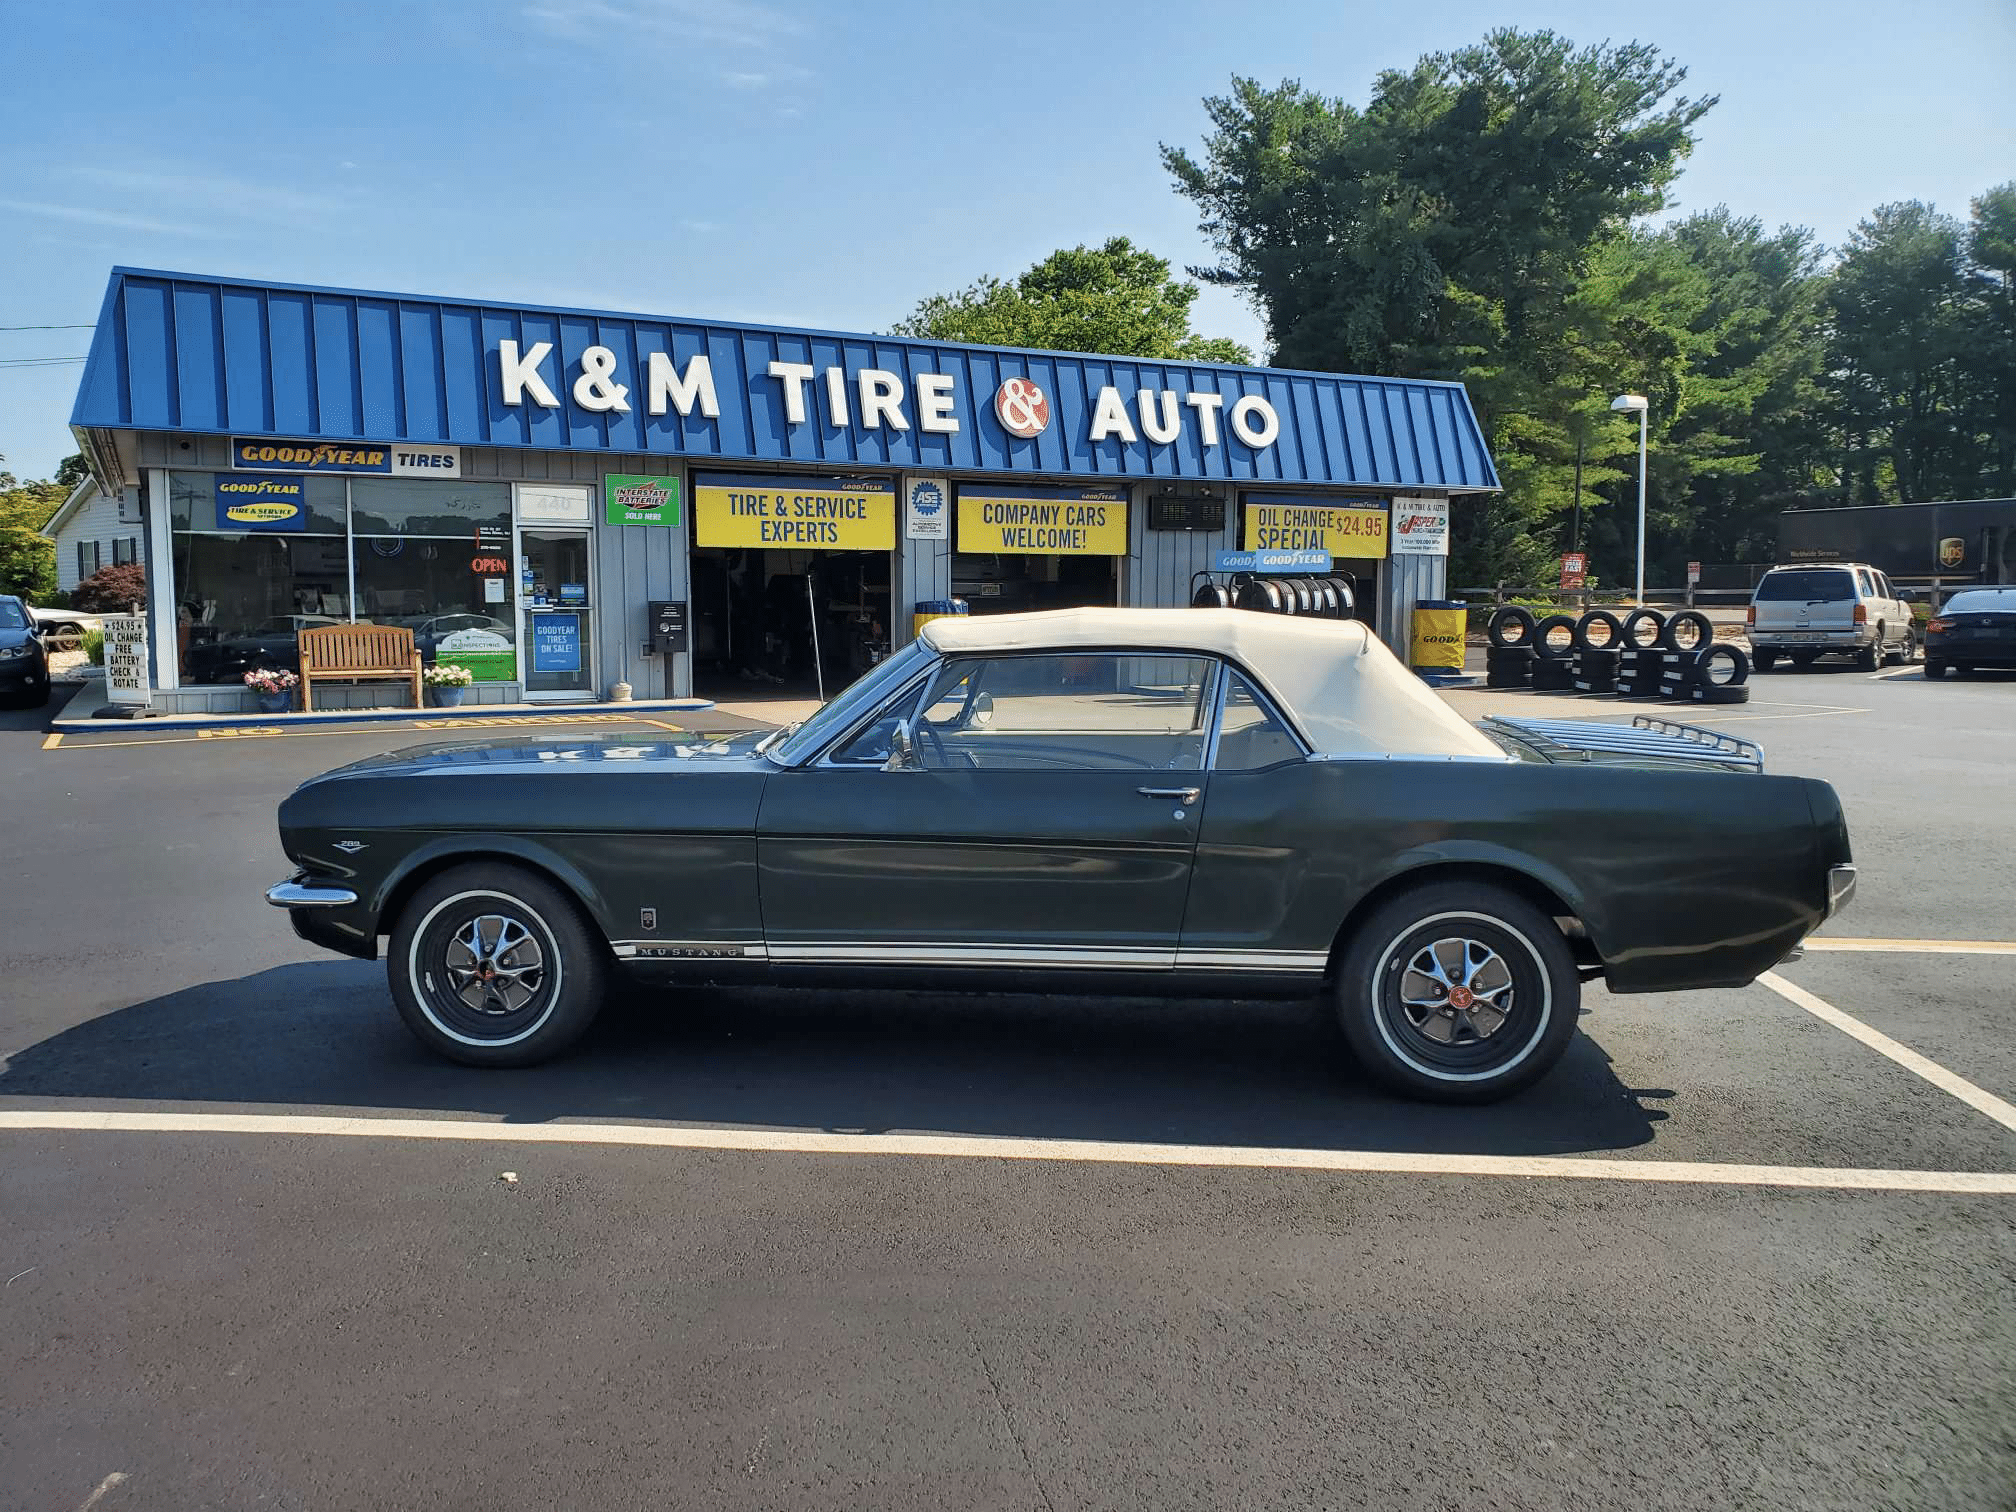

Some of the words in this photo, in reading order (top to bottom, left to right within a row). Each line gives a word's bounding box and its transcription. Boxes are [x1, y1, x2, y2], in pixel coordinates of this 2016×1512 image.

[500, 339, 561, 409] K
[573, 345, 632, 413] &
[648, 352, 721, 418] M
[768, 361, 960, 433] TIRE
[998, 377, 1048, 436] &
[1089, 386, 1280, 449] AUTO
[241, 444, 384, 467] GOODYEAR
[398, 453, 455, 469] TIRES
[219, 481, 300, 494] GOODYEAR
[841, 482, 882, 491] GOODYEAR
[616, 489, 669, 497] INTERSTATE
[916, 491, 938, 504] ASE
[1081, 492, 1117, 501] GOODYEAR
[618, 496, 666, 504] BATTERIES
[728, 494, 768, 516] TIRE
[775, 496, 788, 517] &
[793, 496, 866, 519] SERVICE
[625, 512, 643, 520] SOLD
[983, 503, 1060, 526] COMPANY
[1066, 506, 1105, 526] CARS
[1258, 508, 1279, 526] OIL
[1283, 509, 1334, 528] CHANGE
[1336, 516, 1382, 536] $24.95
[761, 520, 838, 543] EXPERTS
[1002, 528, 1087, 549] WELCOME!
[1258, 528, 1324, 550] SPECIAL
[1222, 556, 1256, 567] GOOD
[1263, 550, 1325, 566] GOODYEAR
[471, 558, 507, 573] OPEN
[111, 621, 135, 630] $24.95
[537, 626, 576, 635] GOODYEAR
[104, 632, 114, 642] OIL
[117, 632, 142, 642] CHANGE
[546, 635, 567, 644] TIRES
[1423, 634, 1461, 644] GOOD
[115, 644, 132, 653] FREE
[541, 644, 552, 653] ON
[110, 655, 139, 665] BATTERY
[110, 666, 131, 676] CHECK
[113, 679, 139, 688] ROTATE
[198, 728, 284, 738] NO
[640, 948, 738, 956] MUSTANG
